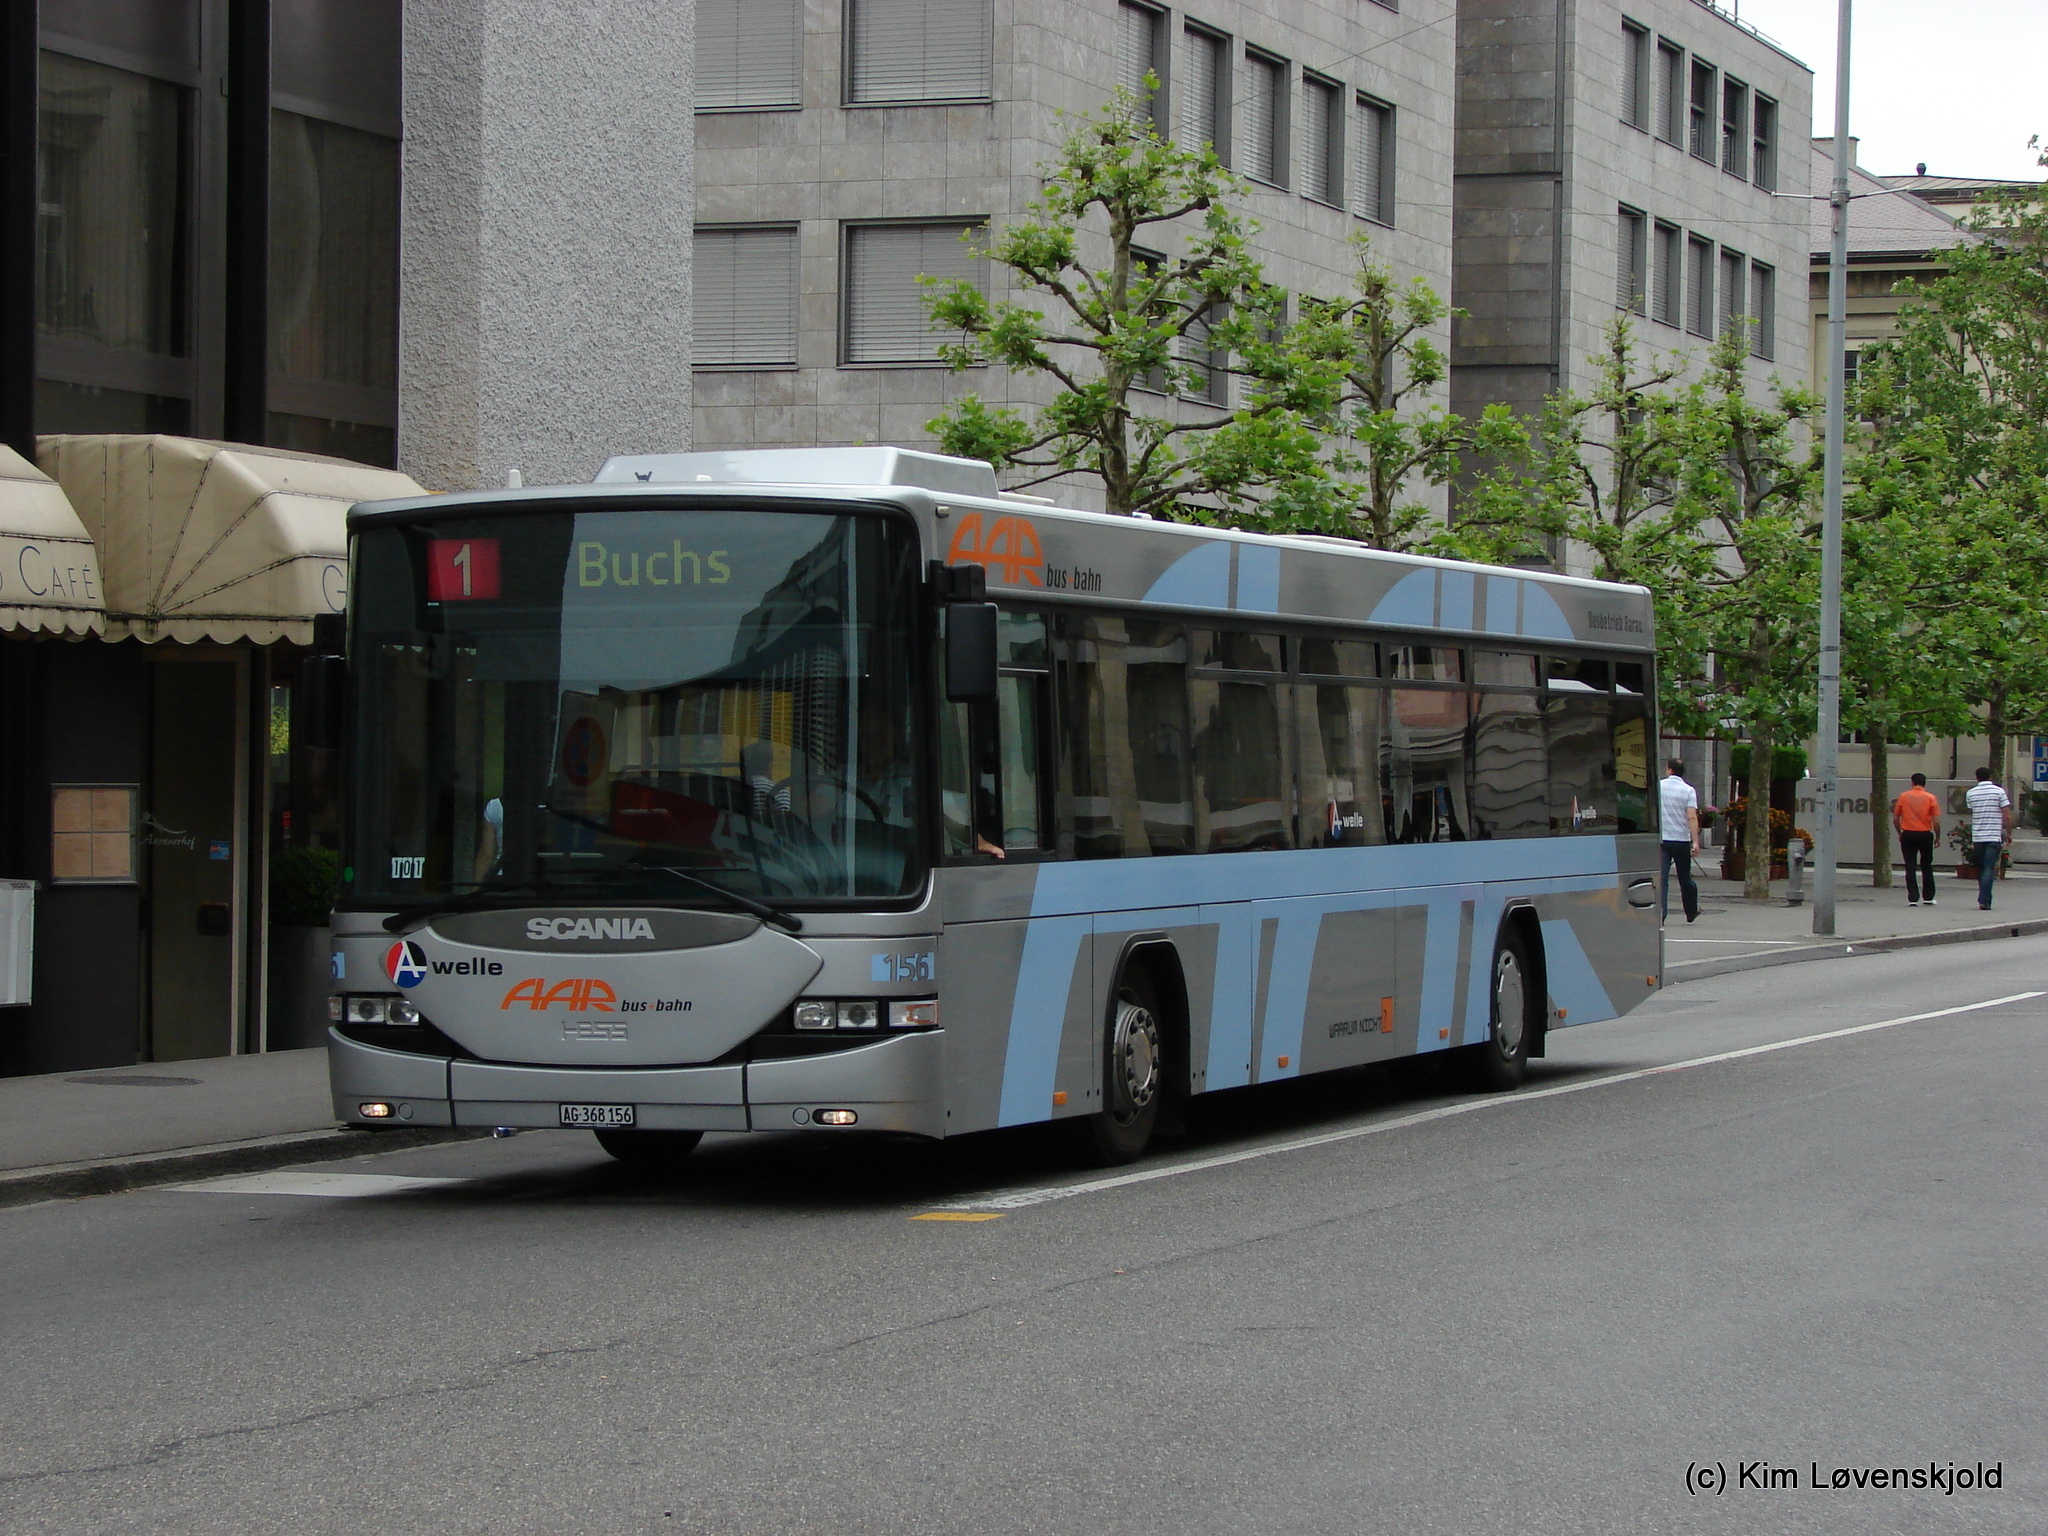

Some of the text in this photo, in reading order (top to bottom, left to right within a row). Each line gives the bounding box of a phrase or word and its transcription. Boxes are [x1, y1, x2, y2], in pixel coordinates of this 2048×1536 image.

[453, 543, 471, 596] 1
[578, 539, 731, 586] Buchs
[1342, 812, 1364, 829] welle
[526, 917, 656, 940] SCANIA
[432, 957, 503, 976] welle
[882, 952, 930, 981] 156
[501, 978, 617, 1012] AAR
[608, 1107, 631, 1122] 156
